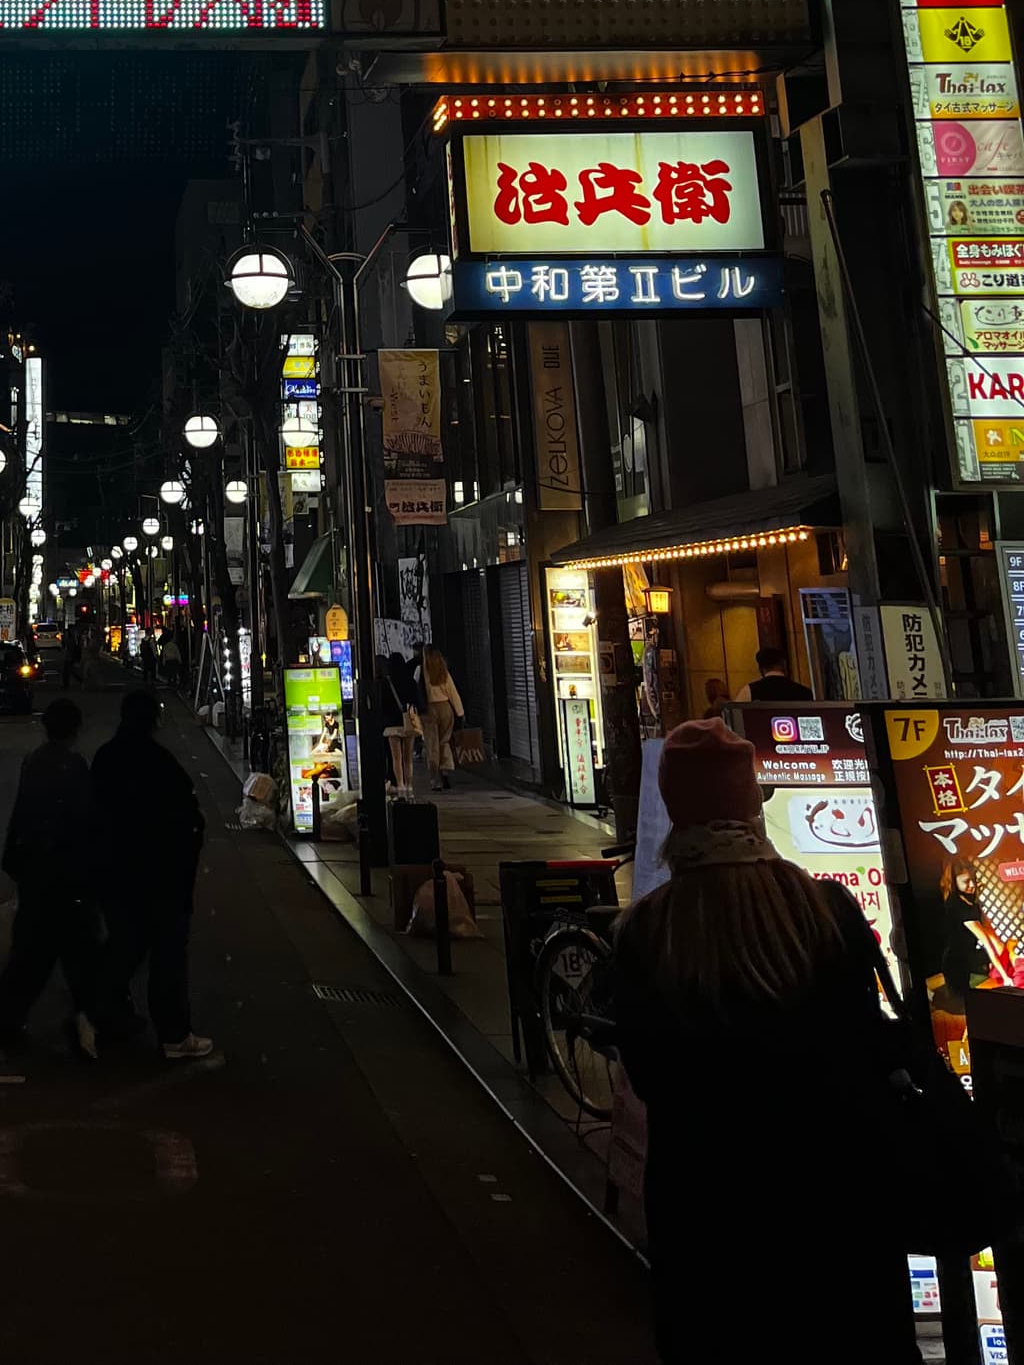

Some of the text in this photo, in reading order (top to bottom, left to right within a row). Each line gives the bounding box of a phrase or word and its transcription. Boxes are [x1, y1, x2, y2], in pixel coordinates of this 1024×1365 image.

[493, 159, 734, 227] 治兵衛
[956, 243, 1024, 258] 全身もみほぐ
[1009, 556, 1022, 567] 9F
[893, 717, 927, 742] 7F
[944, 748, 1024, 761] http://Thai-lax2
[761, 760, 817, 770] Welcome
[831, 758, 869, 770] 欢迎光
[793, 771, 826, 783] Massage
[933, 771, 958, 807] 本格
[812, 870, 860, 886] roma
